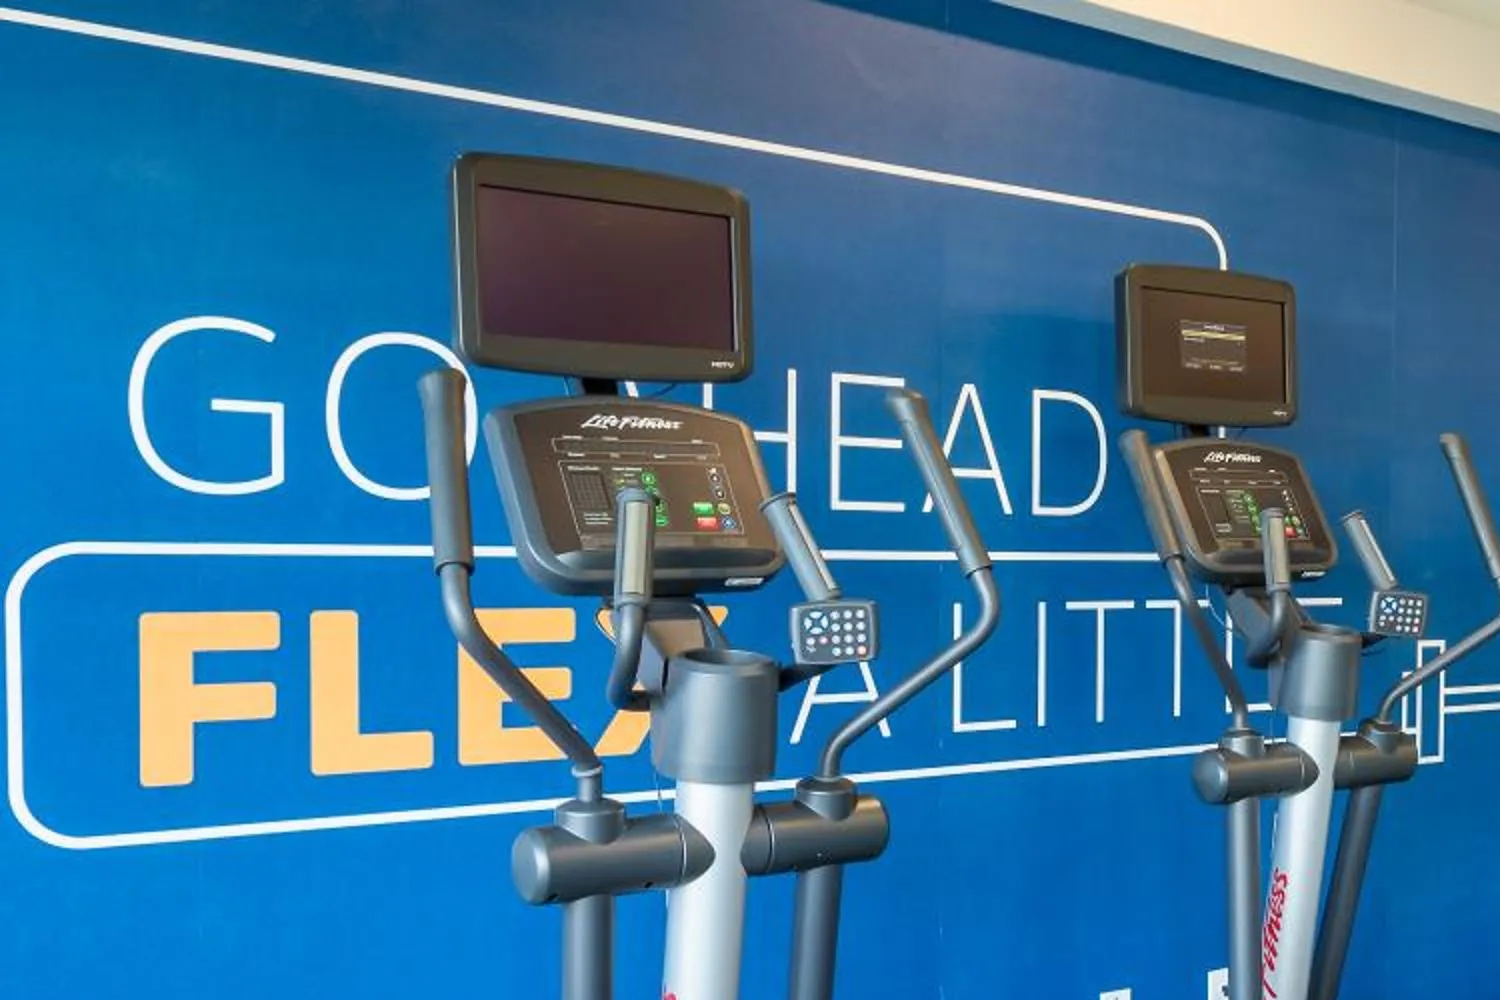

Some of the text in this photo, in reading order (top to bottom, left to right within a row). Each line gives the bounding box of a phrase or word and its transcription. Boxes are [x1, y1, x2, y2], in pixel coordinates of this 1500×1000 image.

[128, 316, 1108, 517] GO HEAD
[790, 661, 892, 744] A
[952, 598, 1343, 733] LITTL
